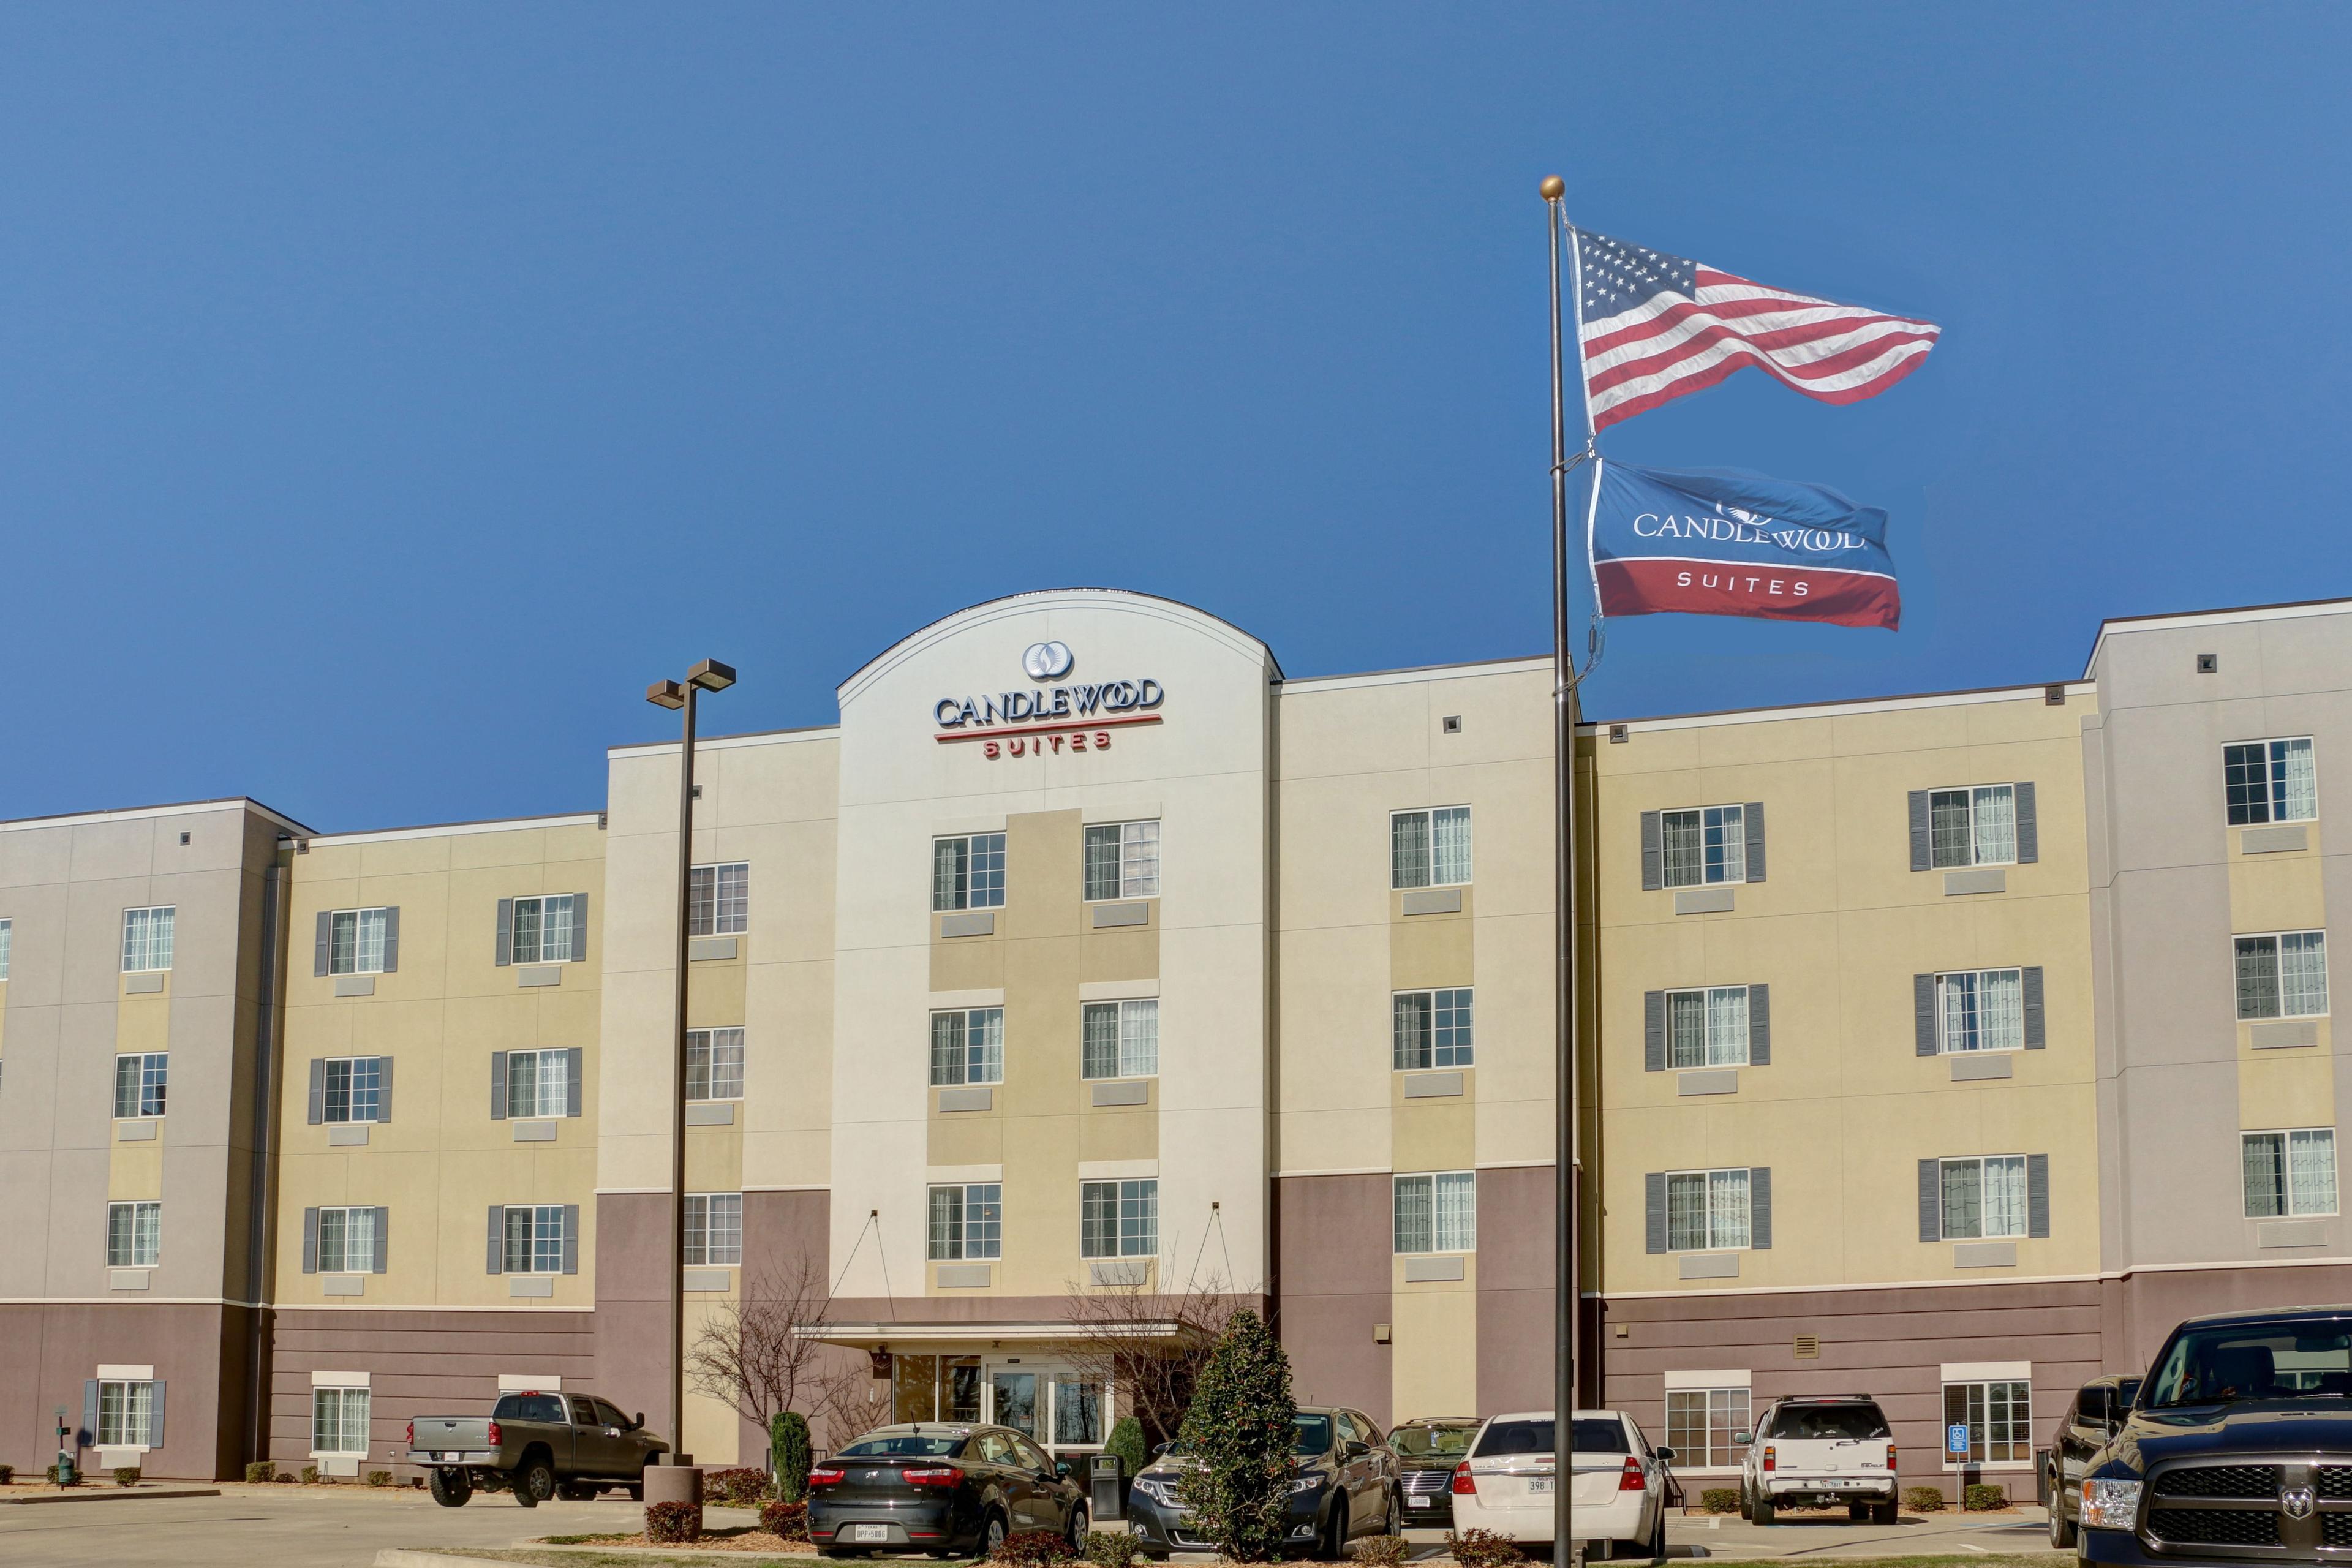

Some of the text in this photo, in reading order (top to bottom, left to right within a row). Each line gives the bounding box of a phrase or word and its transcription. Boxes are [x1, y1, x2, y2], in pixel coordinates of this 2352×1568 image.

[1677, 572, 1809, 596] SUITES
[933, 678, 1164, 726] CANDLEWOOD
[984, 731, 1110, 758] SUITES
[1530, 1481, 1545, 1490] 398
